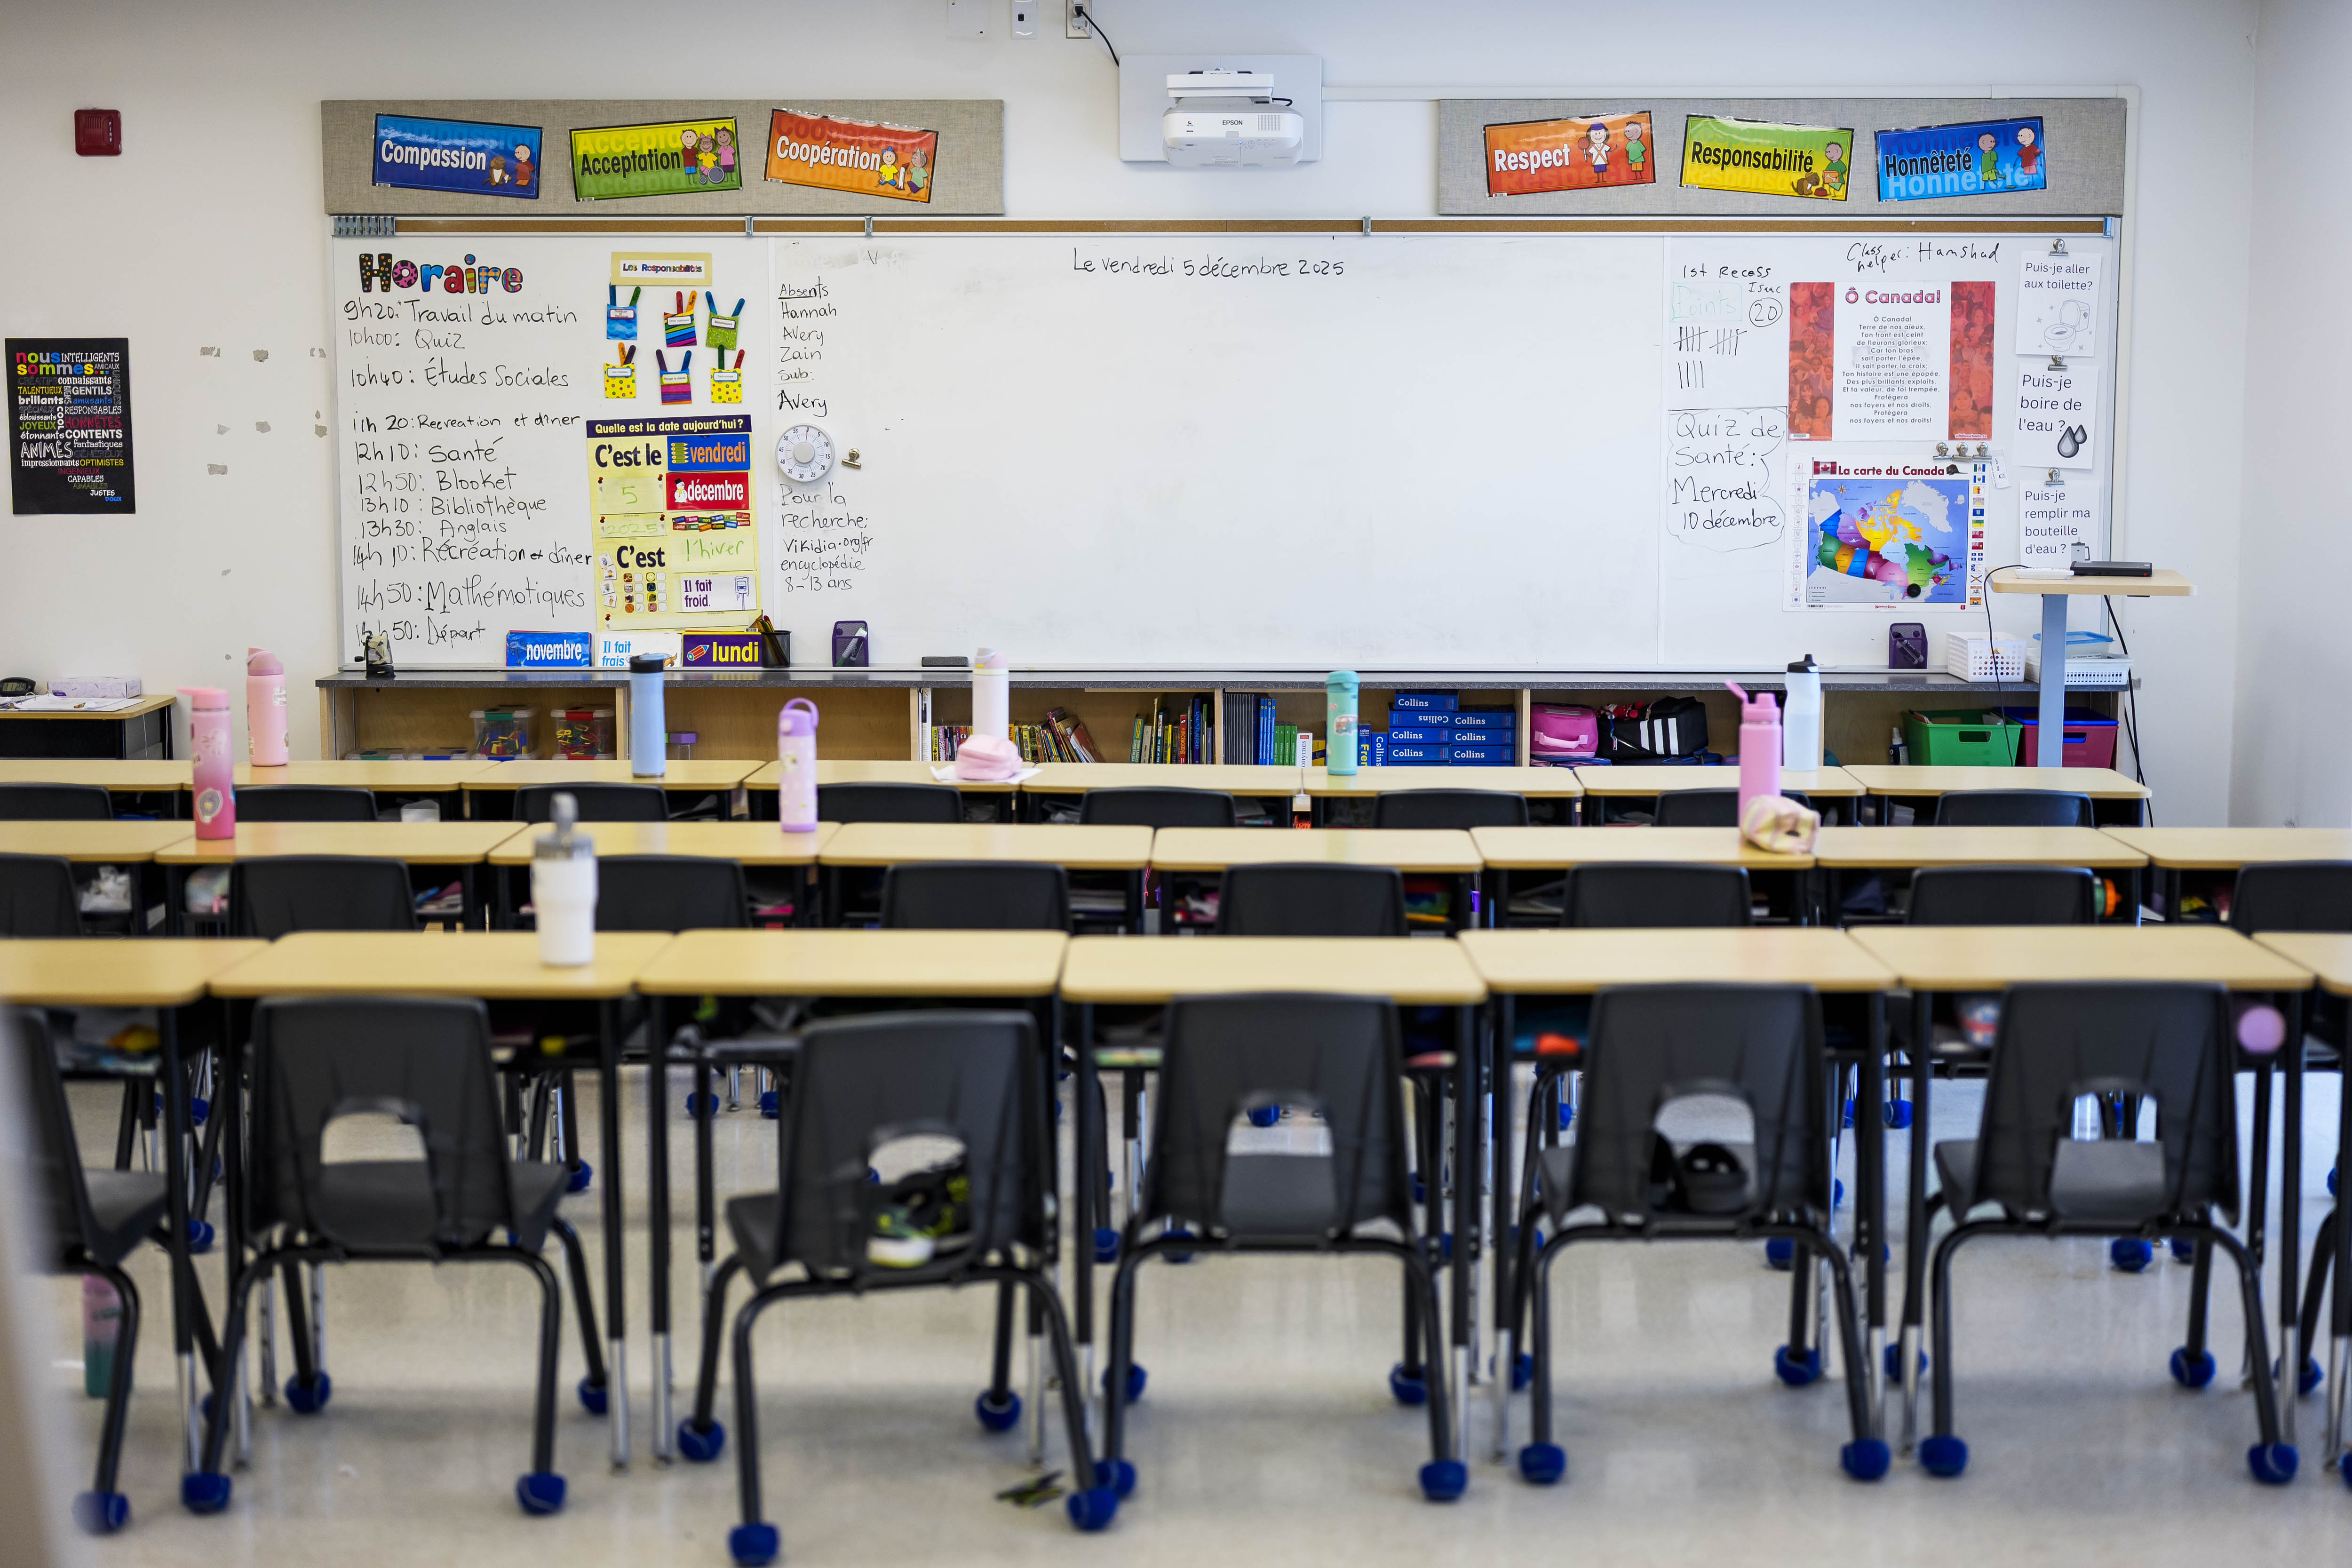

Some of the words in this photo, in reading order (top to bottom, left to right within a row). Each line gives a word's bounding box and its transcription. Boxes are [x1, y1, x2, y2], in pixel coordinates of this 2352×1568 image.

[381, 139, 486, 171] Compassion
[776, 135, 881, 173] Coopération
[1494, 143, 1571, 177] Respect
[1691, 141, 1813, 174] Responsabilité
[1885, 147, 1972, 177] Honnêteté
[580, 151, 681, 180] Acceptation
[1847, 242, 1883, 262] Class
[1858, 246, 1909, 273] helper:
[1073, 247, 1096, 272] Le
[1184, 260, 1195, 276] 5
[1200, 254, 1290, 278] décembre
[1299, 260, 1344, 276] 2025
[1684, 263, 1707, 278] 1st
[1719, 266, 1771, 278] Recess
[2026, 263, 2062, 276] Puis-je
[2066, 263, 2090, 274] aller
[359, 253, 523, 294] Horaire
[779, 276, 828, 299] Absents
[2047, 280, 2092, 291] toilette?
[1677, 286, 1736, 315] Points
[1845, 287, 1859, 303] Ô
[1865, 290, 1940, 303] Canada!
[404, 299, 471, 324] Travail
[481, 302, 507, 325] du
[514, 306, 577, 323] matin
[782, 301, 836, 319] Hannah
[1755, 303, 1777, 321] 20
[415, 329, 465, 349] Quiz
[783, 326, 823, 346] Avery
[16, 352, 61, 363] nous
[62, 352, 119, 363] INTELLIGENTS
[780, 347, 821, 362] Zain
[58, 376, 112, 385] connaissants
[425, 357, 487, 387] Études
[495, 365, 569, 387] Sociales
[18, 386, 63, 394] TALENTUEUX
[72, 386, 112, 395] GENTILS
[2022, 374, 2072, 391] Puis-je
[18, 396, 64, 405] brillants
[777, 390, 826, 417] Avery
[2020, 397, 2058, 411] boire
[2064, 398, 2082, 411] de
[65, 406, 121, 414] RESPONSABLES
[20, 422, 56, 430] JOYEUX
[65, 416, 122, 429] HONNÊTES
[515, 414, 527, 426] et
[534, 413, 580, 426] dîner
[596, 423, 625, 434] Quelle
[629, 422, 643, 432] est
[647, 422, 655, 432] la
[659, 421, 679, 431] date
[1677, 413, 1740, 438] Quiz
[1752, 416, 1780, 438] de
[2018, 418, 2052, 431] l'eau
[20, 430, 64, 439] étonnants
[65, 430, 122, 439] CONTENTS
[21, 440, 73, 458] ANIMÉS
[73, 439, 123, 450] fantastiques
[429, 437, 504, 462] Santé
[690, 442, 746, 463] vendredi
[21, 459, 79, 467] impressionnants
[595, 444, 640, 468] C'est
[646, 443, 662, 466] le
[437, 466, 516, 491] Blooket
[1838, 466, 1853, 475] La
[1886, 466, 1899, 475] du
[1903, 466, 1944, 476] Canada
[621, 486, 638, 504] 5
[687, 479, 743, 501] décembre
[780, 484, 820, 506] Pour
[1673, 476, 1756, 504] Mercredi
[2026, 490, 2065, 503] Puis-je
[432, 495, 547, 520] Bibliothèque
[2026, 508, 2068, 521] remplir
[1684, 512, 1698, 530] 10
[1703, 508, 1780, 529] décembre
[440, 519, 507, 541] Anglais
[606, 523, 658, 534] 2025
[2026, 525, 2077, 536] bouteille
[422, 536, 525, 563] Récréation
[616, 545, 665, 568] C'est
[685, 538, 744, 561] l'hiver
[2026, 544, 2056, 554] d'eau
[780, 554, 865, 580] encyclopédie
[684, 579, 692, 592] Il
[695, 579, 712, 592] fait
[827, 578, 852, 590] ans
[684, 593, 710, 607] froid.
[428, 616, 485, 648] Départ
[526, 639, 582, 661] novembre
[603, 641, 611, 653] Il
[614, 640, 631, 653] fait
[713, 641, 759, 662] lundi
[602, 655, 627, 667] frais.
